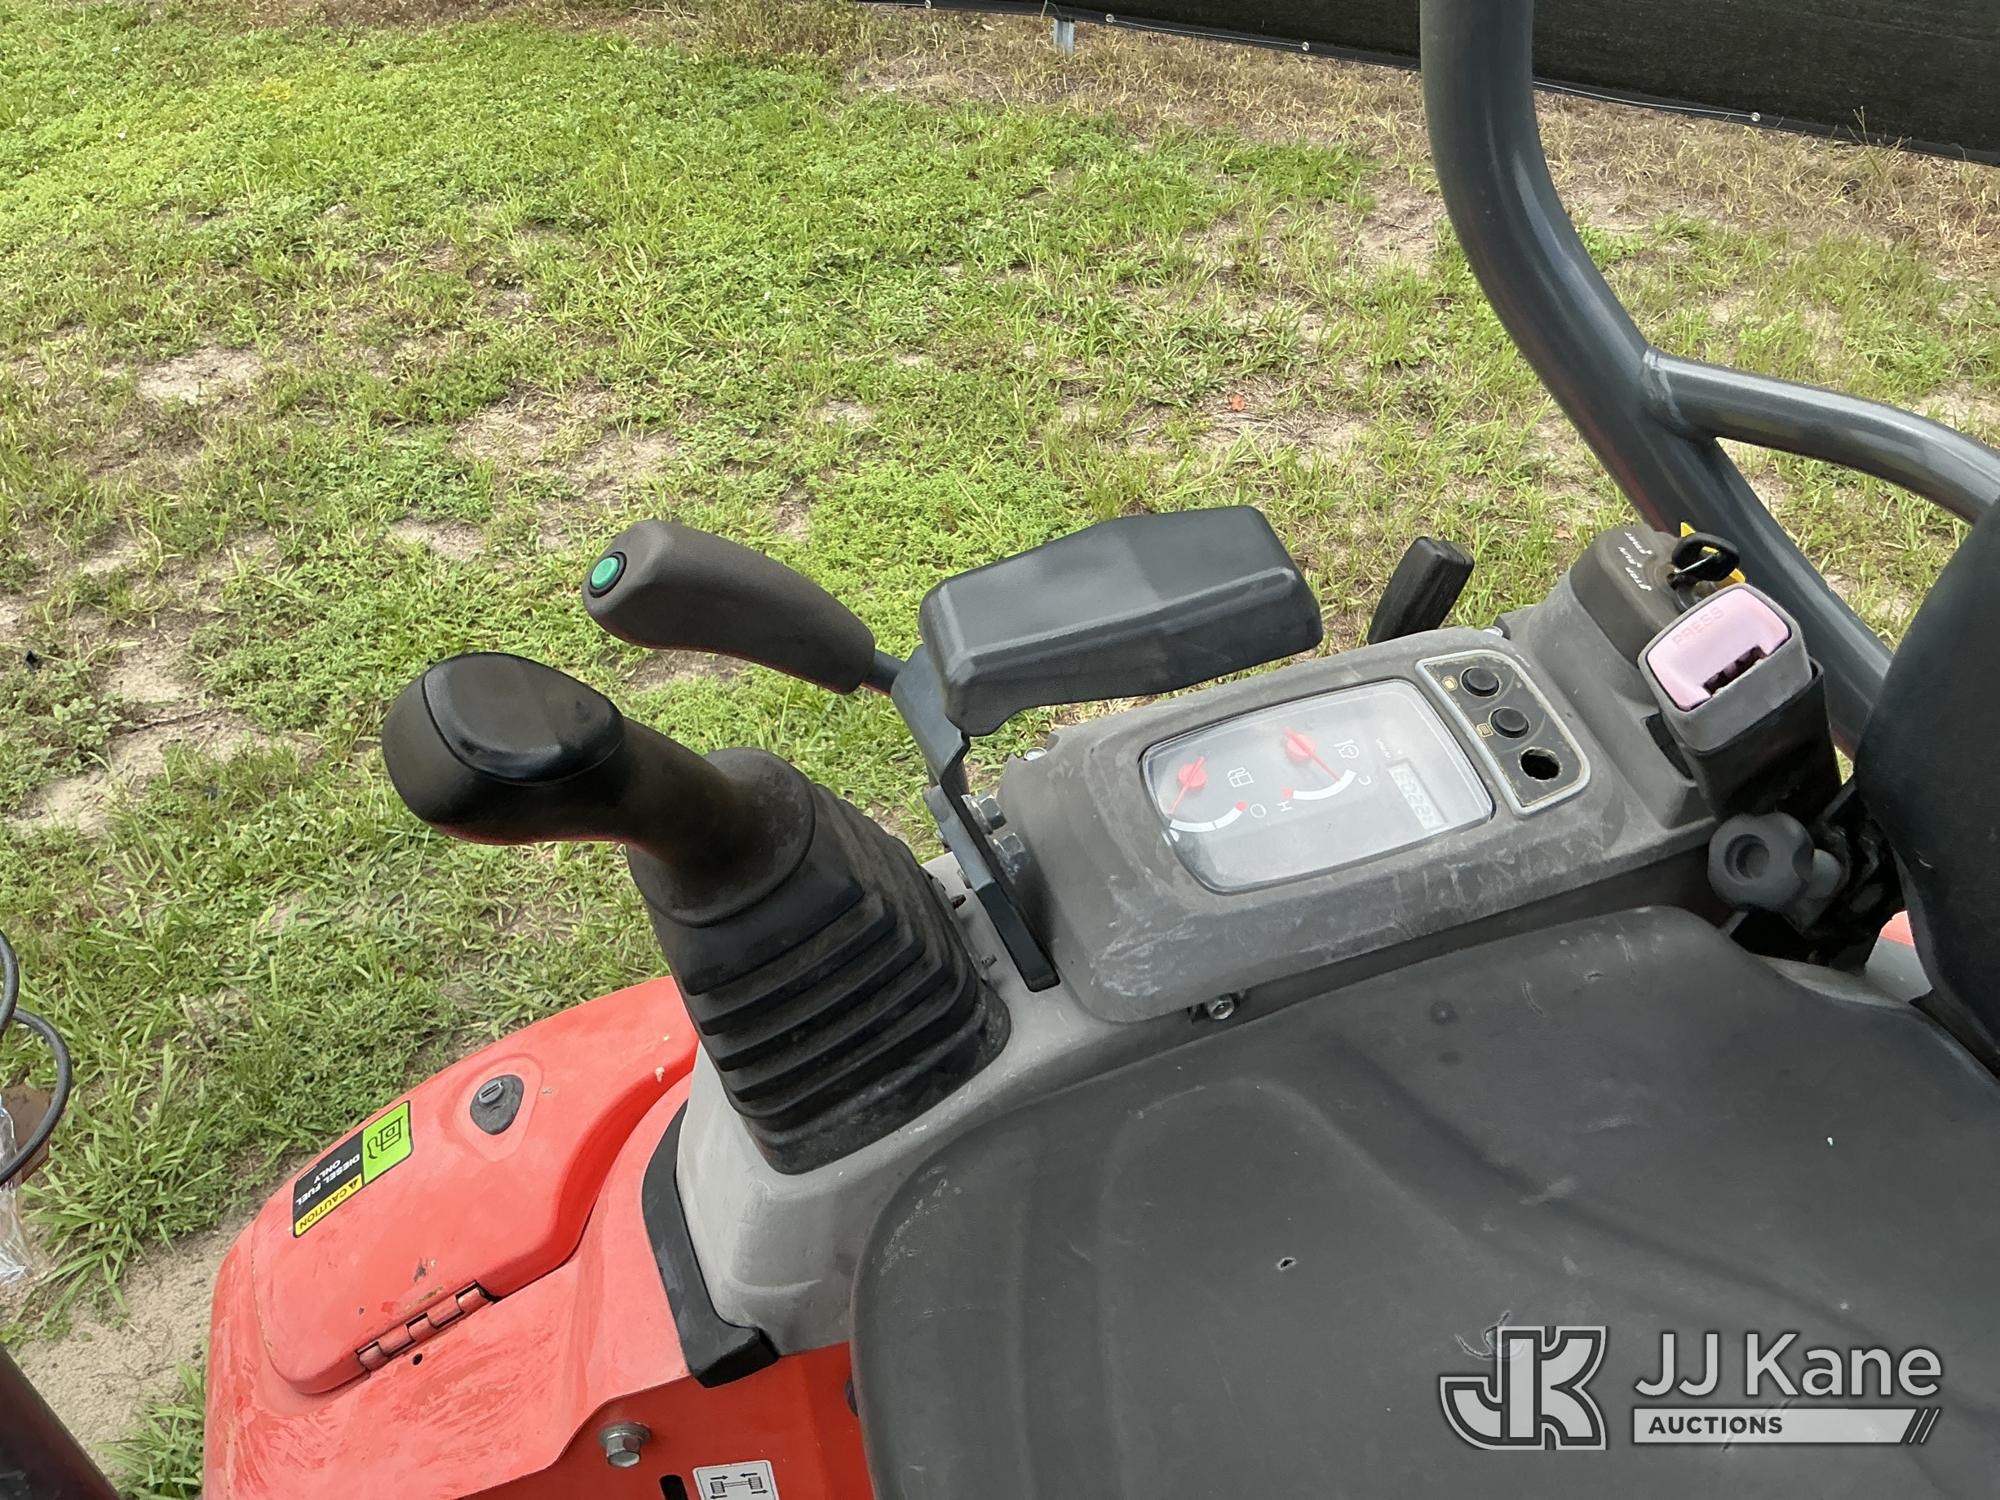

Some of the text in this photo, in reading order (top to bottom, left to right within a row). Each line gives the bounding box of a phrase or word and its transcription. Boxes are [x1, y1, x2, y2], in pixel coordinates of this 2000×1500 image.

[1618, 546, 1636, 565] RUN
[1625, 567, 1646, 590] STOP
[1672, 606, 1724, 646] PRESS
[1277, 801, 1293, 812] H
[295, 1153, 360, 1206] DIESEL FUEL
[313, 1159, 341, 1184] ONLY
[299, 1188, 348, 1230] CAUTION
